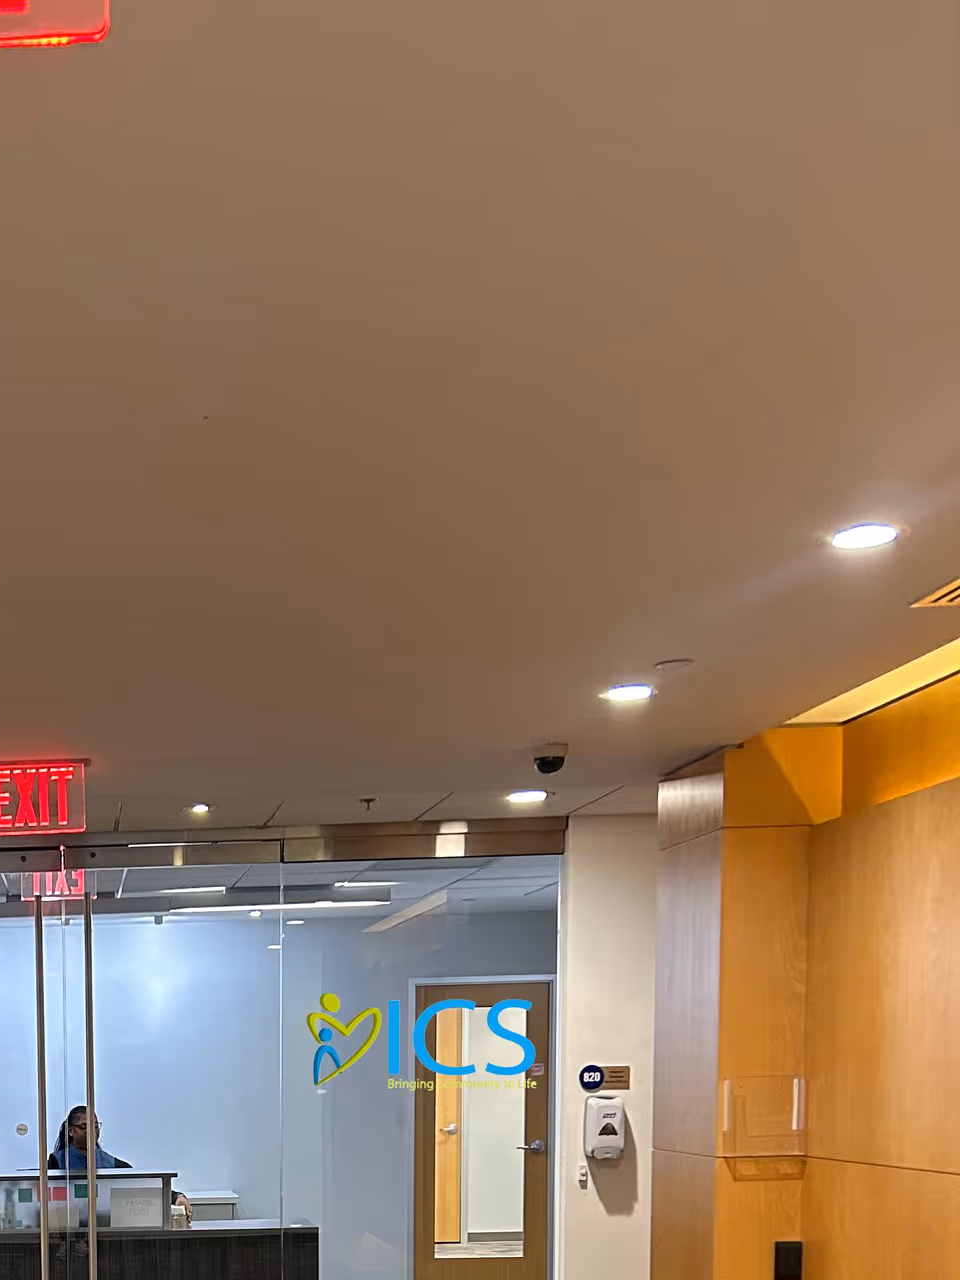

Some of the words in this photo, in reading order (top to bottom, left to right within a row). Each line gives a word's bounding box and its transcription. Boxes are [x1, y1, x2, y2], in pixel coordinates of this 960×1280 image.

[388, 998, 536, 1076] ICS
[583, 1072, 601, 1083] 820
[387, 1078, 434, 1091] Bringing
[517, 1078, 537, 1089] Life
